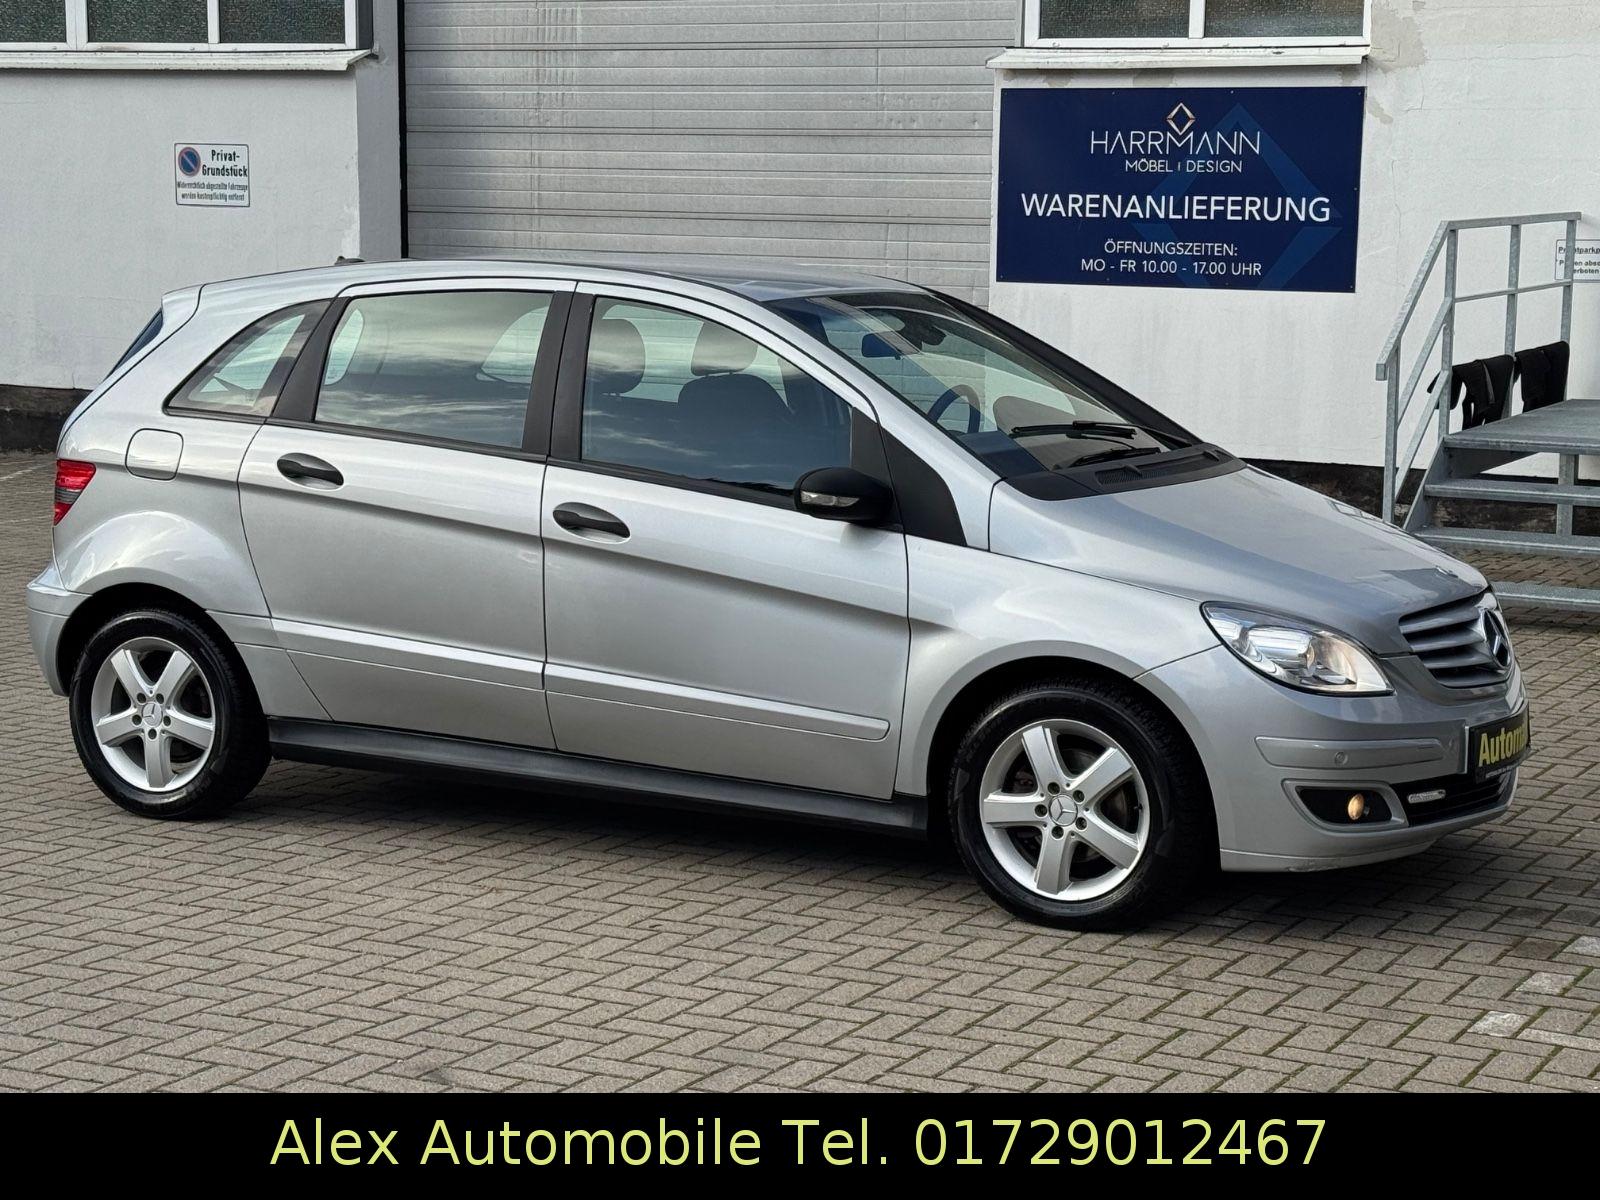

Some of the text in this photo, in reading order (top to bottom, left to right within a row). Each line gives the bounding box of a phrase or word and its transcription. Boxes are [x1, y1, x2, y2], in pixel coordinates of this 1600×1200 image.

[1090, 130, 1261, 155] HARRMANN
[212, 150, 240, 162] Privat-
[1125, 157, 1173, 172] MÖBEL
[1186, 160, 1243, 173] DESIGN
[202, 164, 247, 176] Grundstück
[1021, 192, 1331, 222] WARENANLIEFERUNG
[1103, 238, 1239, 257] ÖFFNUNGSZEITEN:
[1081, 258, 1106, 272] MO
[1120, 260, 1136, 273] FR
[1142, 260, 1177, 274] 10.00
[1192, 261, 1227, 275] 17.00
[1231, 262, 1262, 276] UHR
